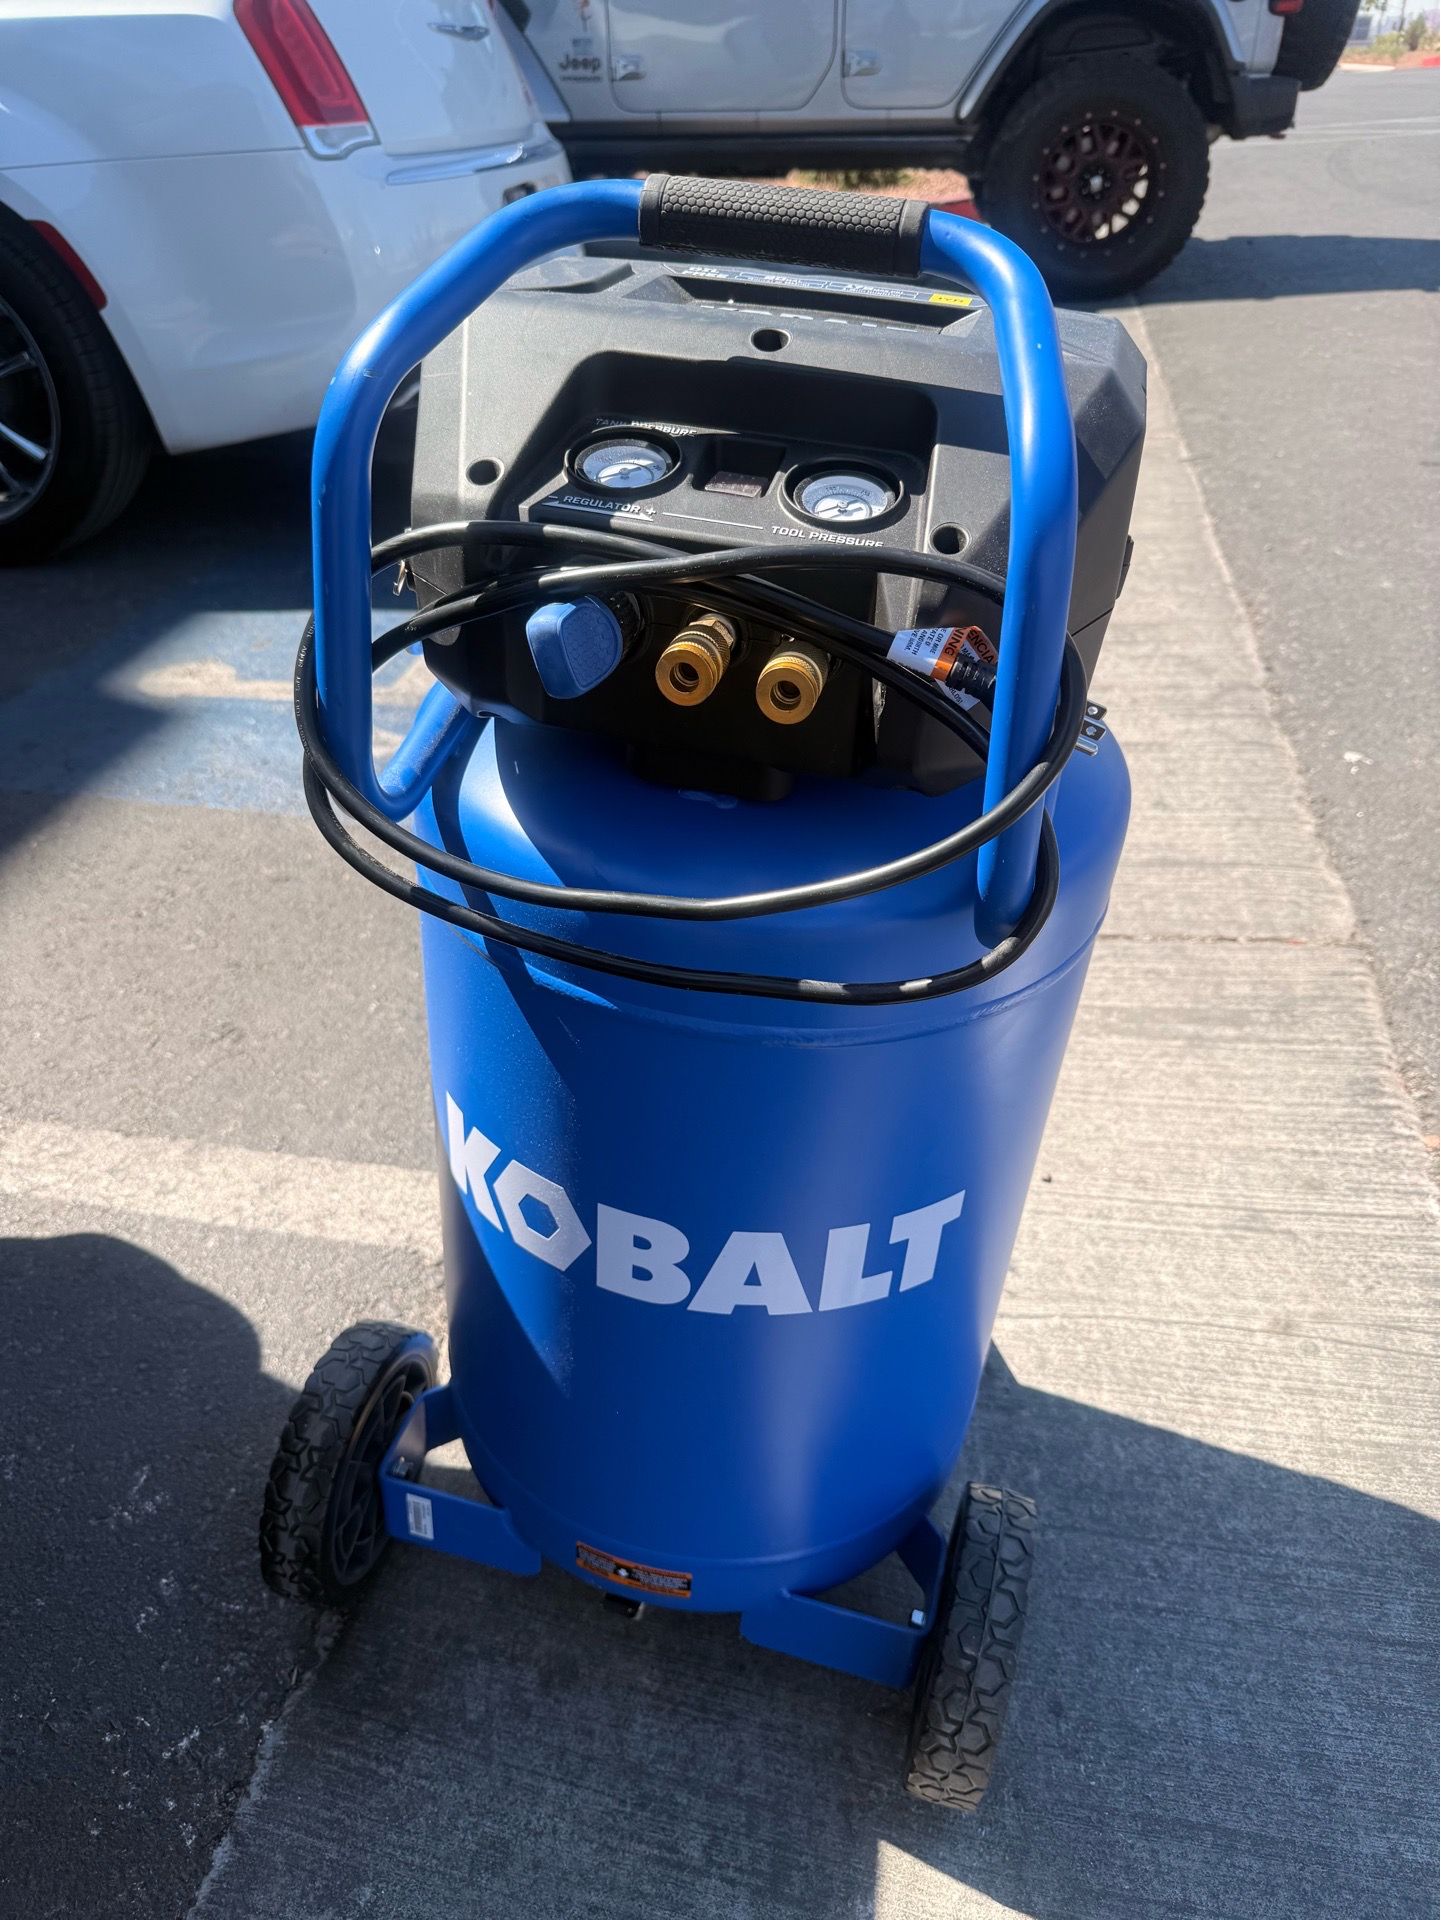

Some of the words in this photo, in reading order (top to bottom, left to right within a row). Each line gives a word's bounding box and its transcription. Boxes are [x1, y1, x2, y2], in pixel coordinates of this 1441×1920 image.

[559, 54, 601, 73] Jeep
[563, 495, 641, 513] REGULATOR
[772, 526, 806, 538] TOOL
[446, 1090, 966, 1316] KOBALT
